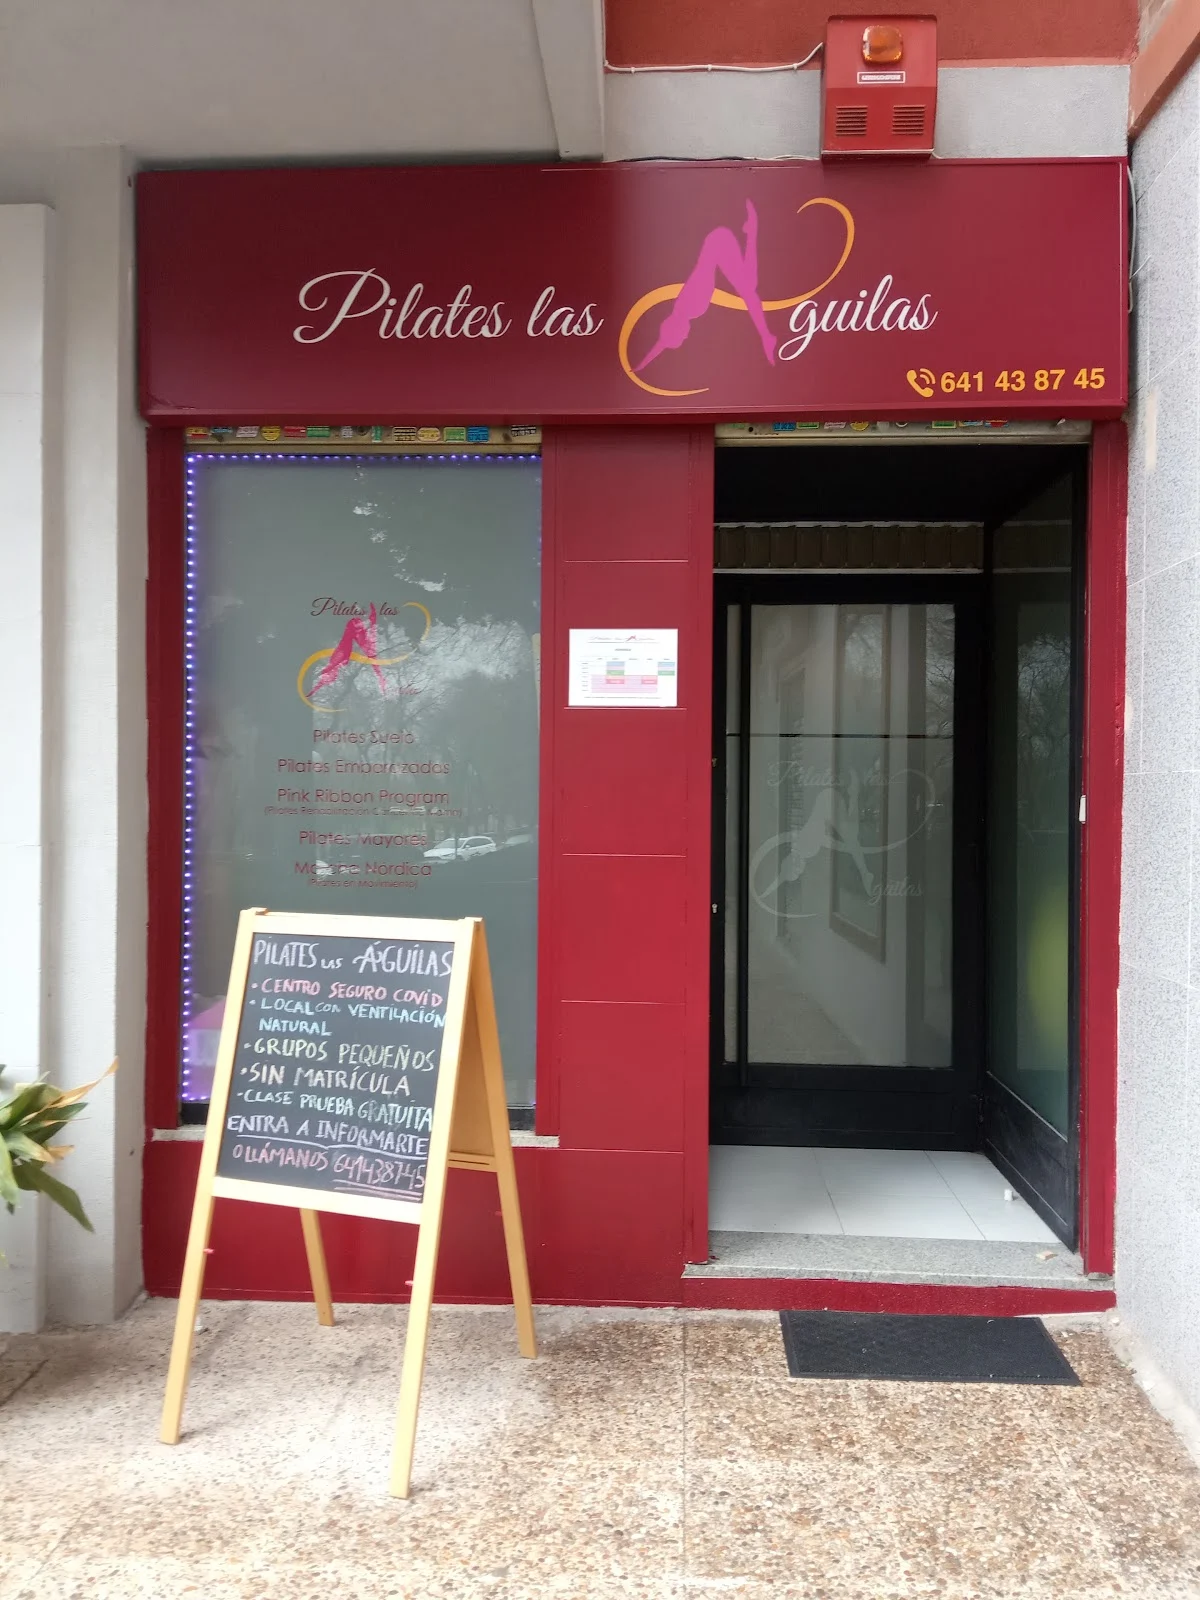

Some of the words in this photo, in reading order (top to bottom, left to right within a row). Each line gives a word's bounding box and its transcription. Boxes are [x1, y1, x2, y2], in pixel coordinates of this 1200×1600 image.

[293, 268, 512, 344] Pilates
[526, 286, 604, 337] las
[940, 371, 984, 393] 641
[995, 370, 1026, 392] 43
[1034, 369, 1066, 391] 87
[1073, 367, 1106, 389] 45
[313, 729, 365, 744] Pilates
[277, 758, 329, 773] Pilates
[277, 788, 310, 803] Pink
[315, 788, 374, 803] Ribbon
[379, 789, 449, 807] Program
[299, 830, 351, 845] Pilates
[358, 832, 427, 848] Mayores
[253, 937, 319, 969] PILATES
[261, 978, 321, 995] CENTRO
[328, 981, 387, 1000] SEGURO
[259, 1017, 332, 1036] NATURAL
[260, 998, 314, 1015] LOCAL
[348, 1003, 447, 1028] VENTILACIÓN
[254, 1037, 328, 1061] GRUPOS
[338, 1043, 436, 1071] PEQUEÑOS
[248, 1062, 285, 1084] SIN
[293, 1066, 411, 1097] MATRÍCULA
[243, 1089, 294, 1105] CLASE
[300, 1093, 355, 1117] PRUEBA
[358, 1100, 432, 1132] GRATUITA
[227, 1115, 289, 1134] ENTRA
[296, 1119, 310, 1137] A
[315, 1119, 429, 1155] INFORMARTE
[333, 1153, 426, 1189] 641438745
